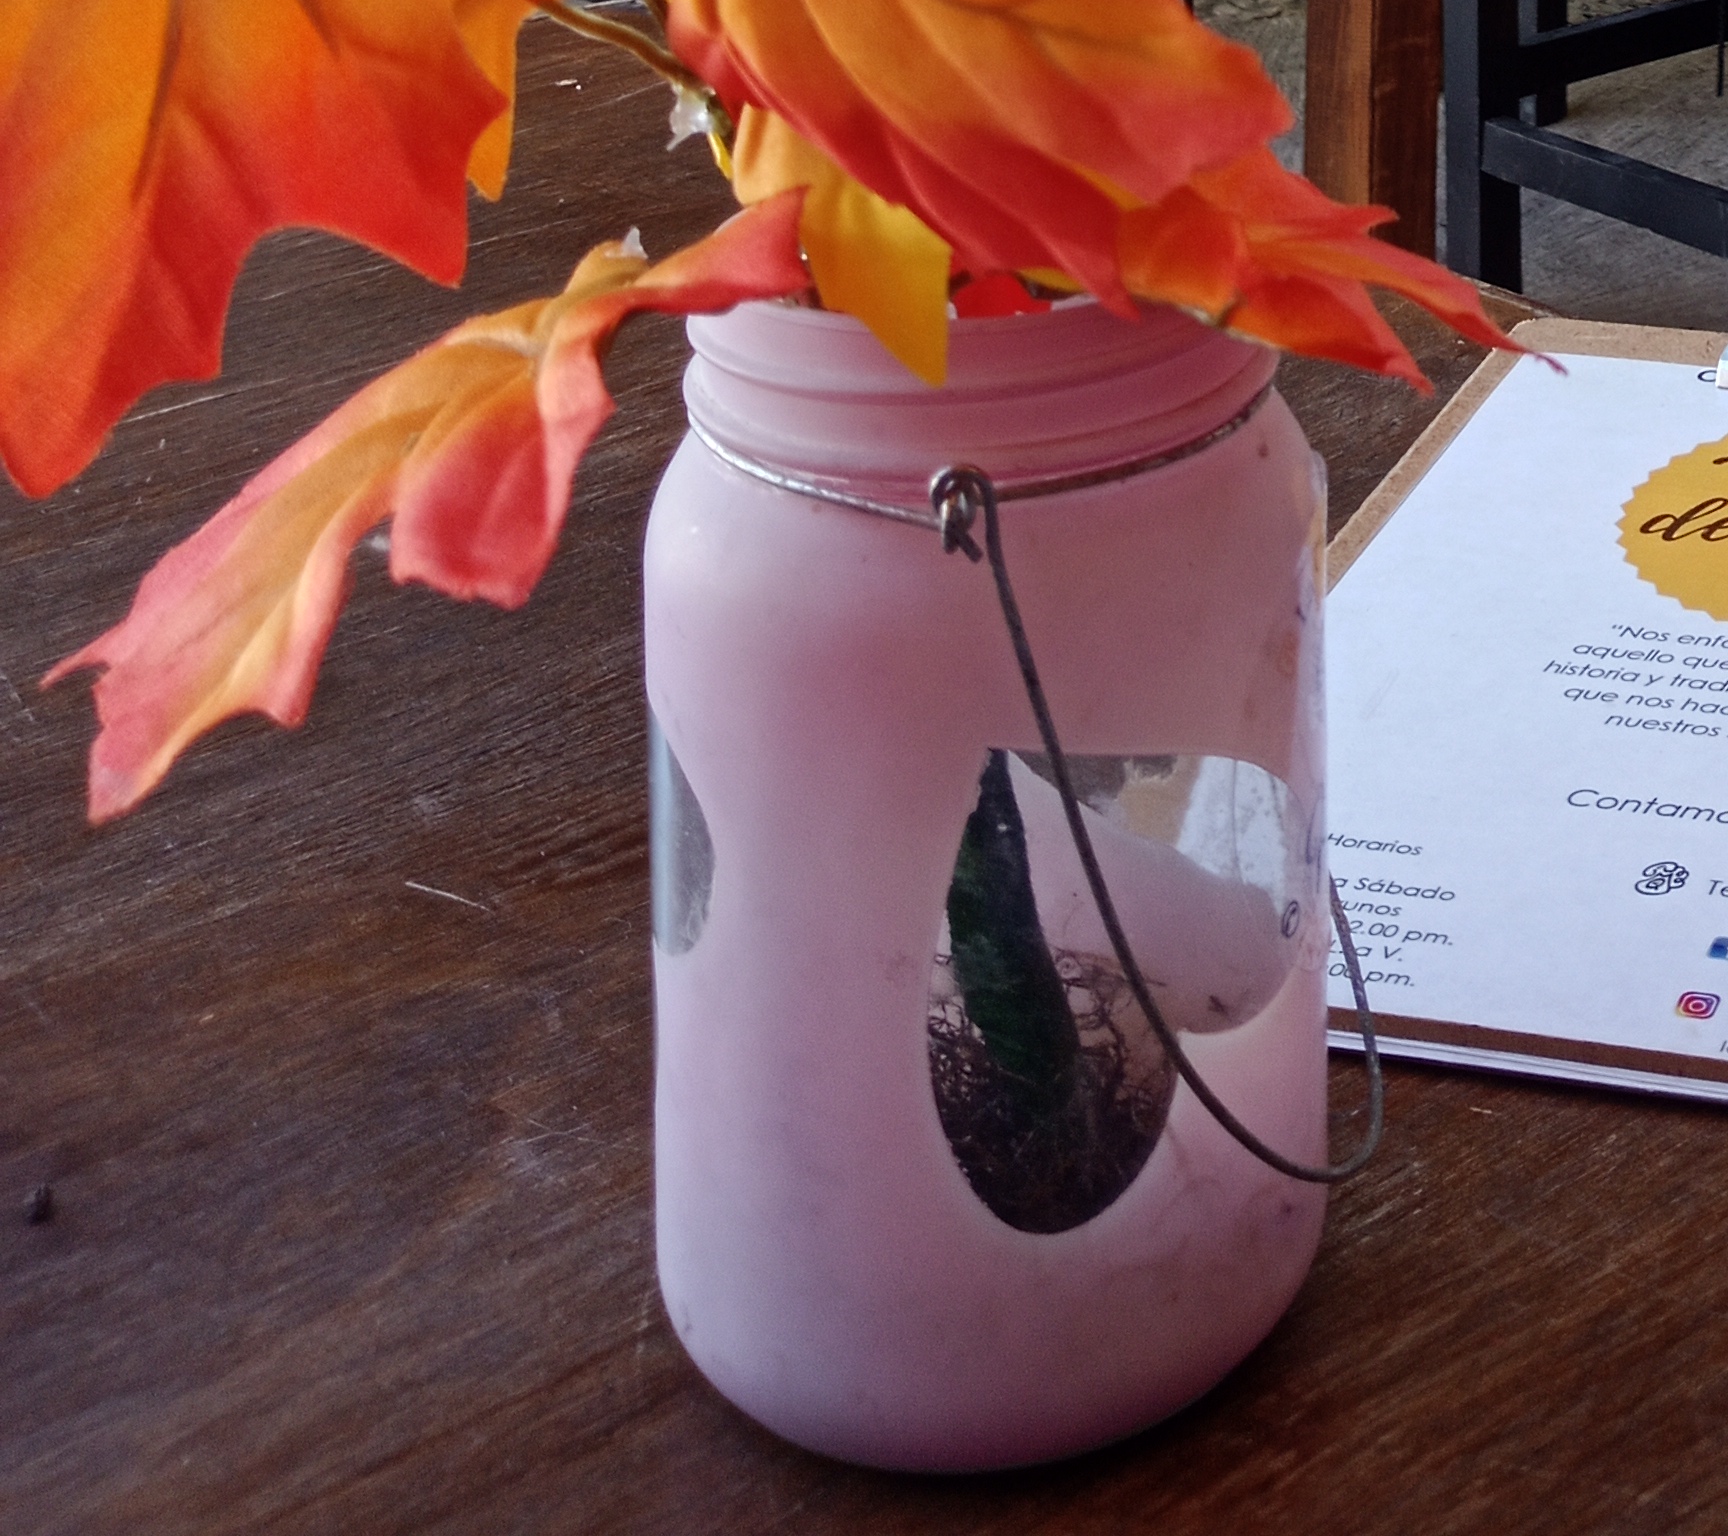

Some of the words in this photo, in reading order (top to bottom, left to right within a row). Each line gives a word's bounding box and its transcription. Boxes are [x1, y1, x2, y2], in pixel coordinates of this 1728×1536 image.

[1572, 643, 1675, 664] aquello
[1543, 660, 1640, 682] historia
[1644, 674, 1664, 686] y
[1563, 688, 1619, 702] que
[1625, 694, 1675, 709] nos
[1604, 714, 1722, 737] nuestros
[1327, 833, 1423, 856] Horarios
[1353, 877, 1456, 901] Sábado
[1401, 930, 1453, 946] pm.
[1384, 945, 1402, 961] V.
[1364, 971, 1415, 987] pm.
